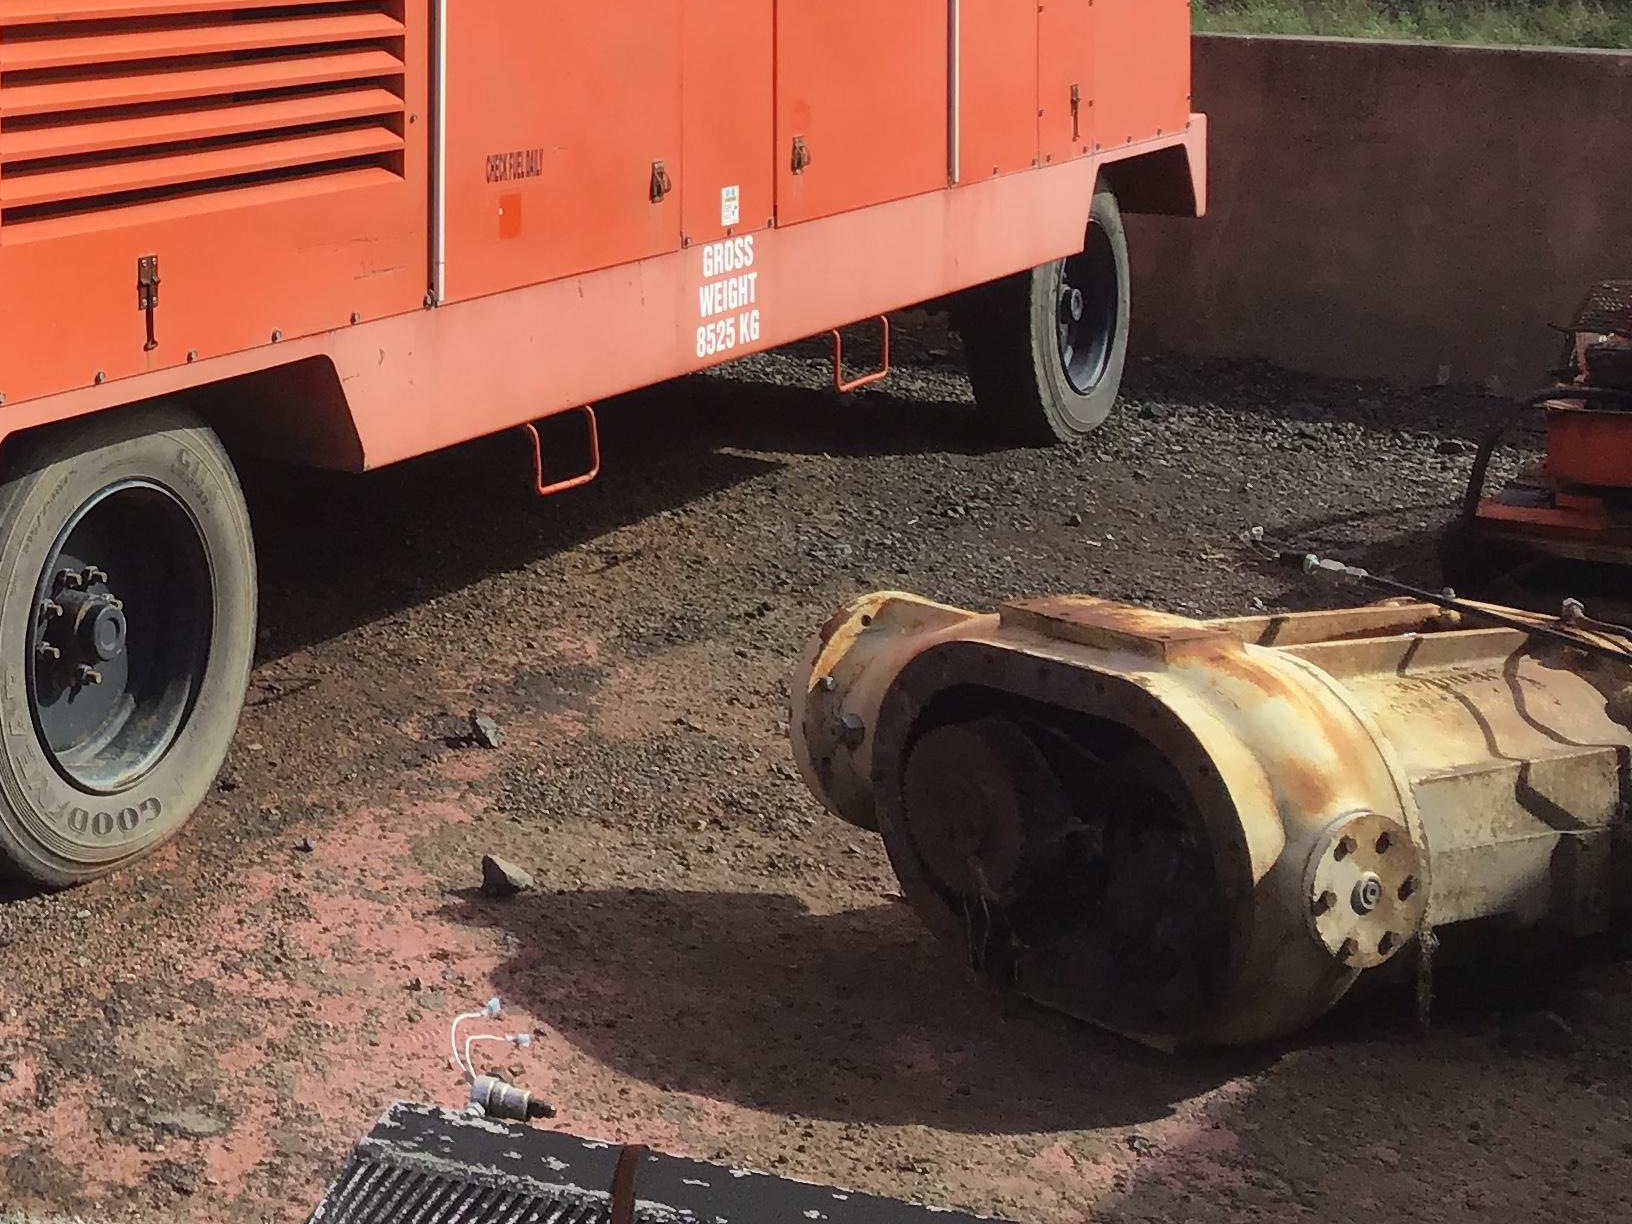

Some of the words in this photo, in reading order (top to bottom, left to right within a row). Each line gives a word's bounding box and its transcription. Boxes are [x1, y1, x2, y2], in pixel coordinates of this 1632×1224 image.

[486, 153, 508, 184] CHECK
[703, 234, 754, 278] GROSS
[699, 272, 758, 318] WEIGHT
[696, 317, 736, 358] 8525
[739, 309, 760, 345] KG
